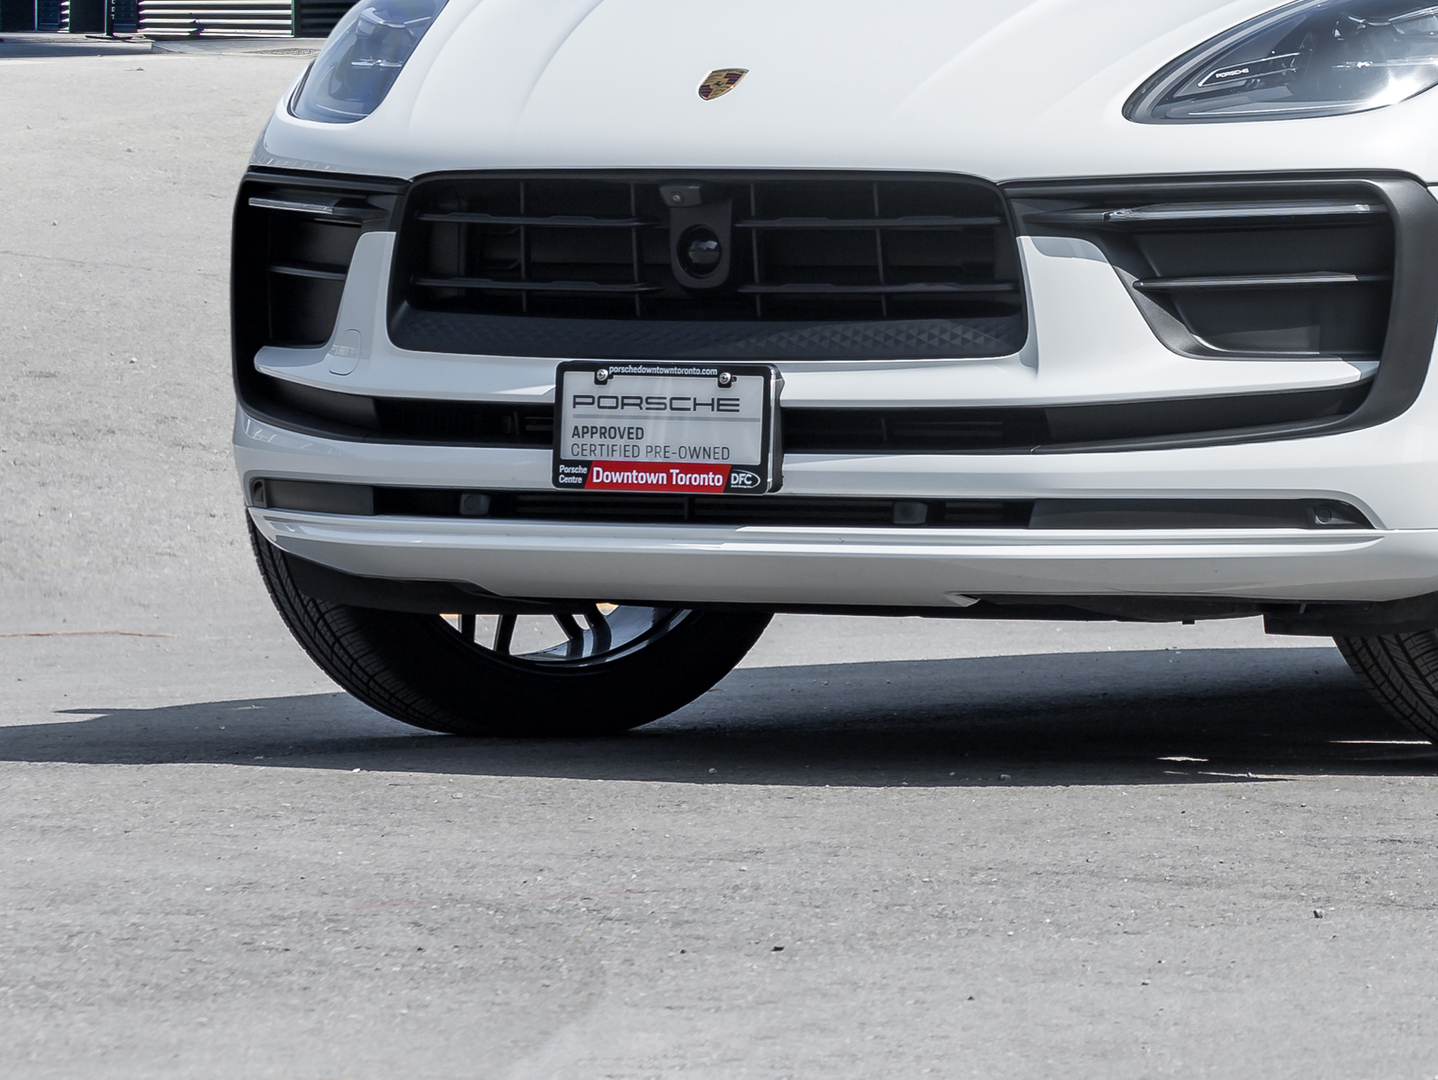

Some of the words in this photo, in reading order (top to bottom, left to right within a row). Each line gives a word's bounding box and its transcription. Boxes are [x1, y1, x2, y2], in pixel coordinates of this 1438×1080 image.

[608, 365, 718, 376] porschedowntowntoronto.com
[572, 394, 741, 413] PORSCHE
[571, 425, 645, 440] APPROVED
[571, 442, 640, 459] CERTIFIED
[645, 445, 730, 461] PRE-OWNED
[559, 465, 588, 475] Porsche
[592, 466, 667, 486] Downtown
[669, 469, 724, 487] Toronto
[559, 474, 583, 484] Centre
[731, 473, 752, 485] DFC
